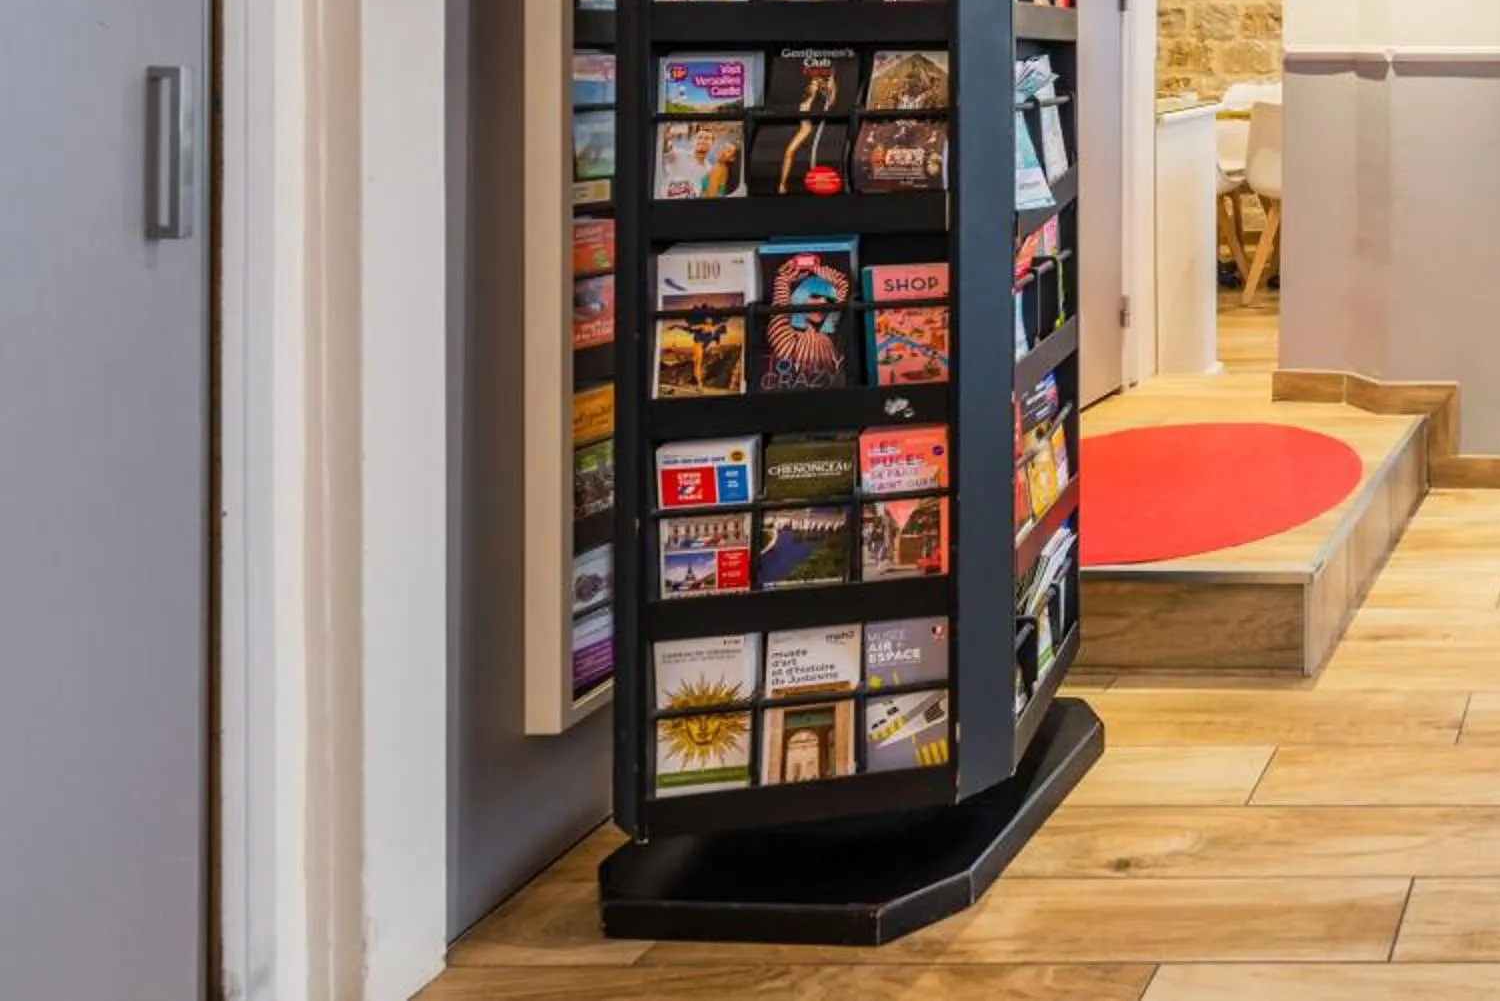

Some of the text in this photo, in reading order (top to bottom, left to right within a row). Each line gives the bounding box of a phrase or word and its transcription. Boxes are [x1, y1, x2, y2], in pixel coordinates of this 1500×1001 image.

[803, 58, 832, 68] Club
[687, 259, 721, 280] LIDO
[883, 275, 939, 293] SHOP
[768, 460, 852, 476] CHENONCEAU
[868, 640, 893, 652] AIR
[868, 648, 921, 664] ESPACE
